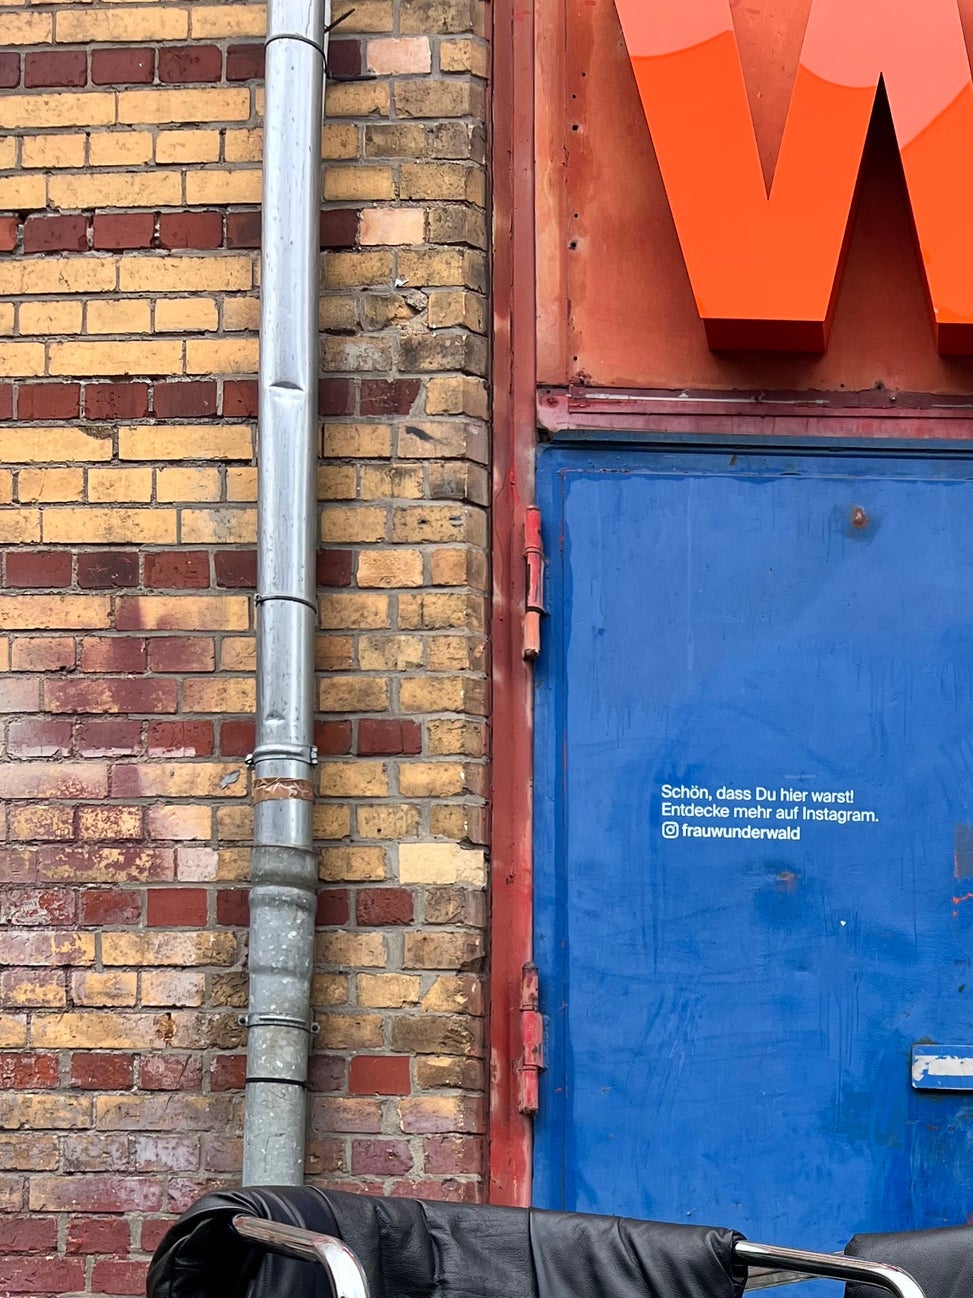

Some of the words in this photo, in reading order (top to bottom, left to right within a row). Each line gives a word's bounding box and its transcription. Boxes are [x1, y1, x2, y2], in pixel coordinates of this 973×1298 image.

[661, 784, 713, 801] Schön,
[716, 786, 751, 800] dass
[755, 788, 776, 801] Du
[780, 788, 807, 802] hier
[811, 789, 854, 803] warst!
[661, 803, 729, 818] Entdecke
[734, 805, 772, 819] mehr
[776, 805, 799, 820] auf
[803, 807, 879, 824] Instagram.
[682, 823, 801, 840] frauwunderwald
